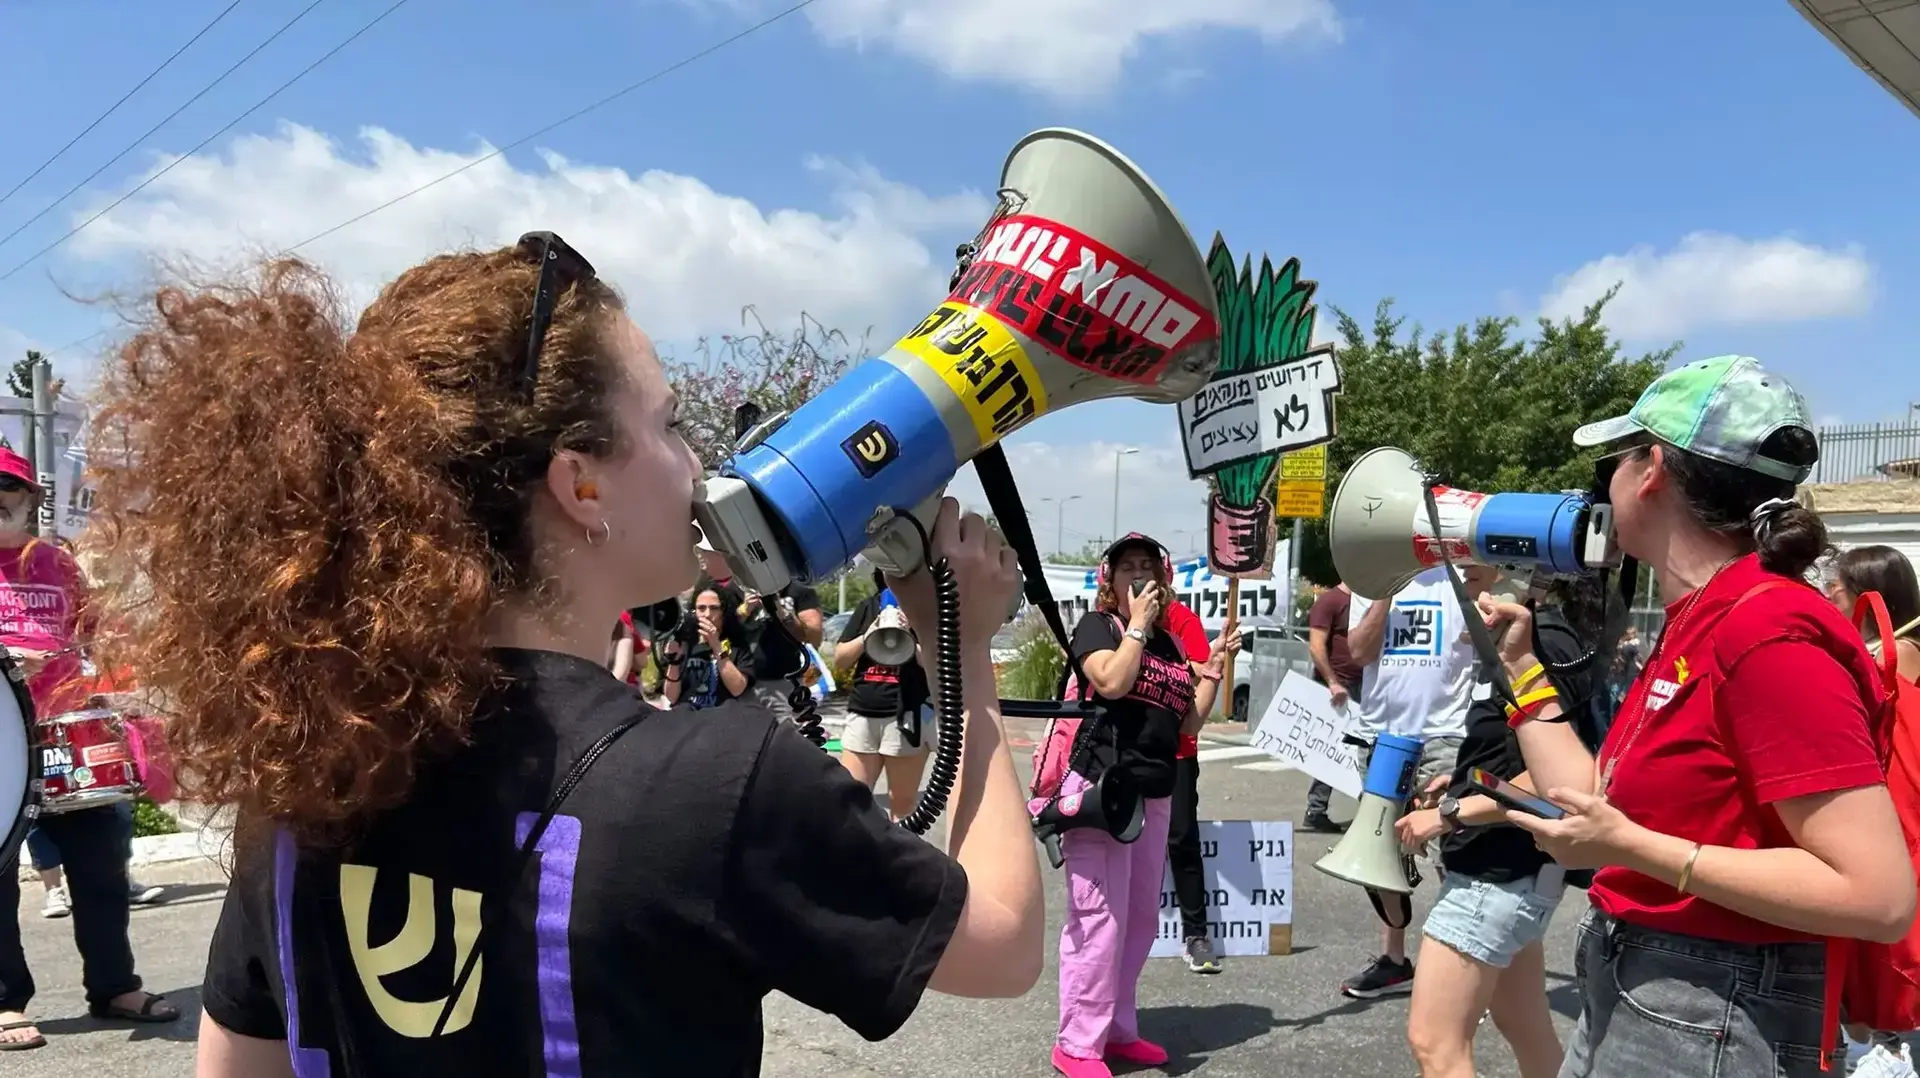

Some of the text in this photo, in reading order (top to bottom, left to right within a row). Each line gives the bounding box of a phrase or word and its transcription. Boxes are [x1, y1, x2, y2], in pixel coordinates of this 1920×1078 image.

[976, 222, 1201, 349] אתה אשם
[1256, 360, 1323, 391] דרושים
[1201, 394, 1309, 454] לא עציצים
[856, 430, 887, 462] ש
[1402, 608, 1432, 627] עד
[1248, 839, 1286, 863] גנץ
[1250, 888, 1286, 906] את
[340, 863, 483, 1039] ש
